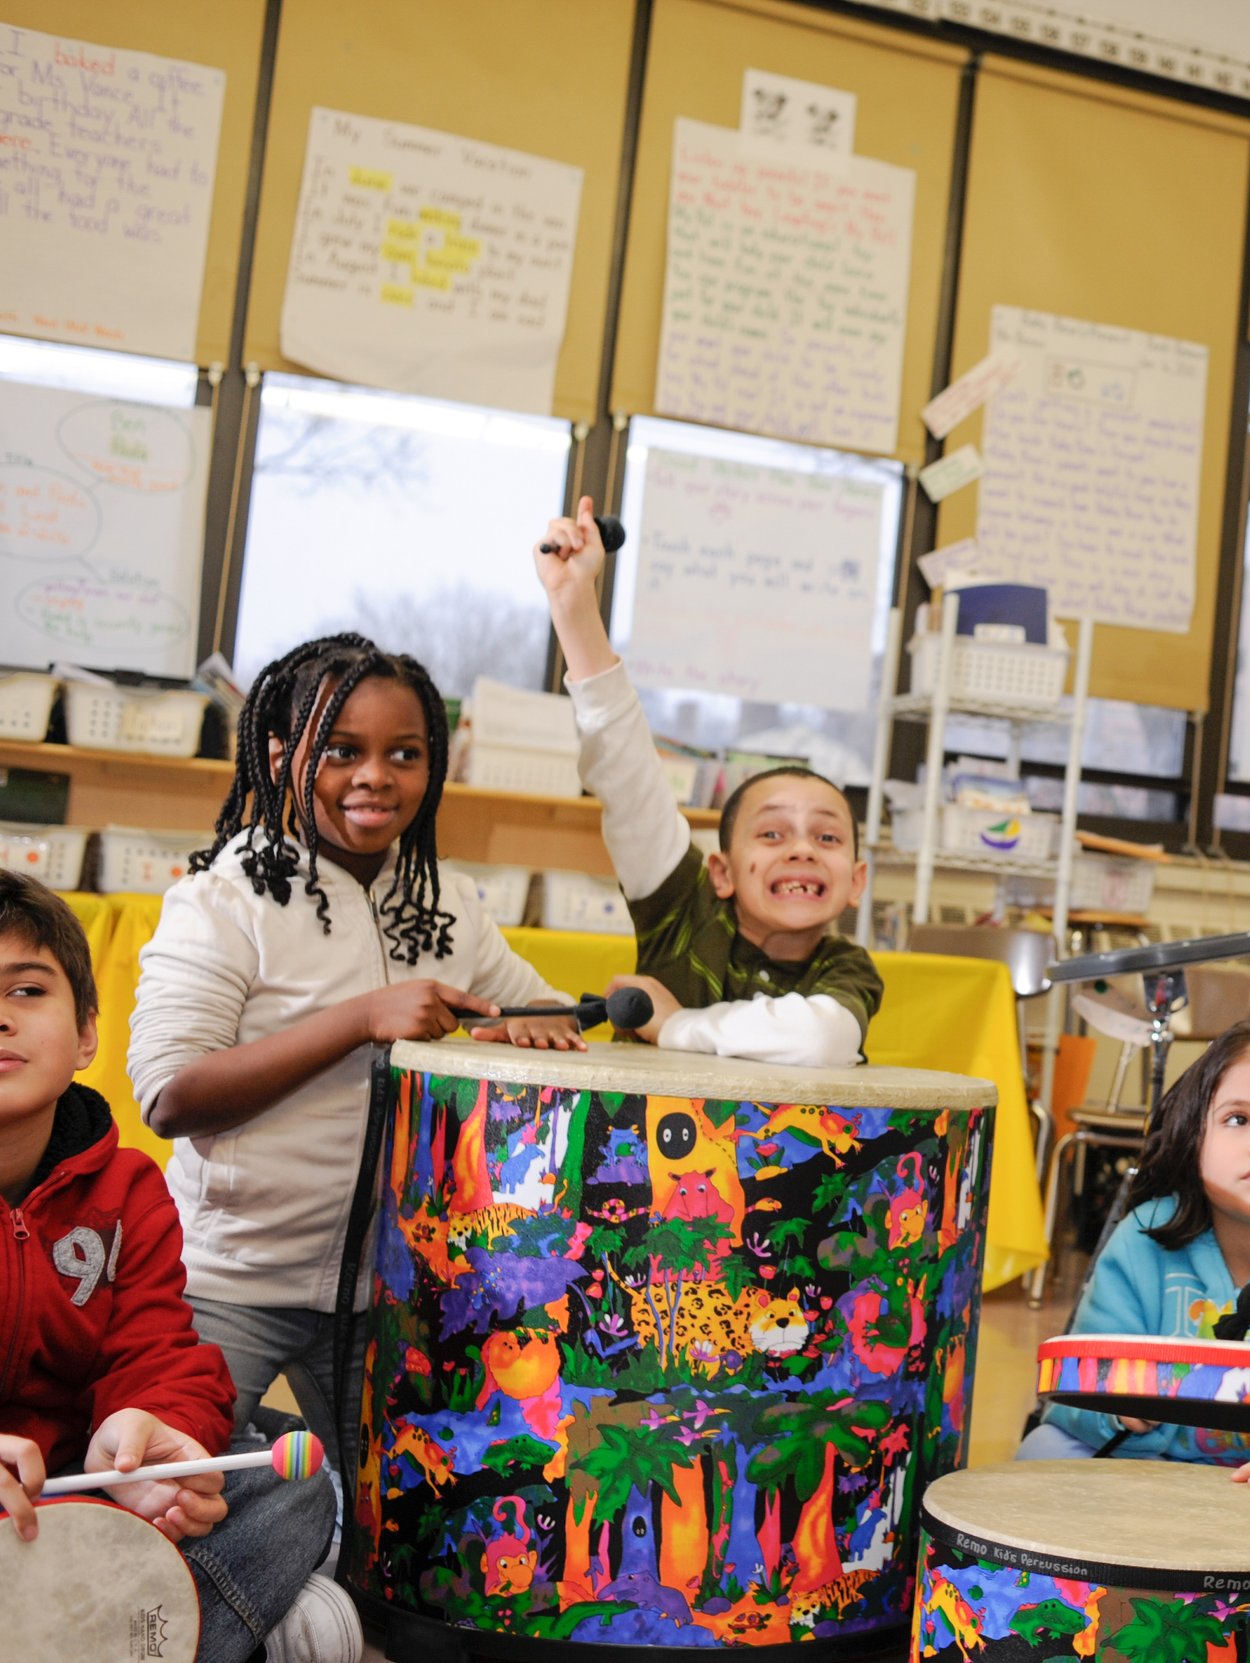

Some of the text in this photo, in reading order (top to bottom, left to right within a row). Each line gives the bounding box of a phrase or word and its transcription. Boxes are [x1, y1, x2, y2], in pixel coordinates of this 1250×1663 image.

[54, 42, 115, 75] baked
[956, 1533, 988, 1557] Remo
[1020, 1552, 1089, 1577] Percussion
[149, 1614, 158, 1653] REMO
